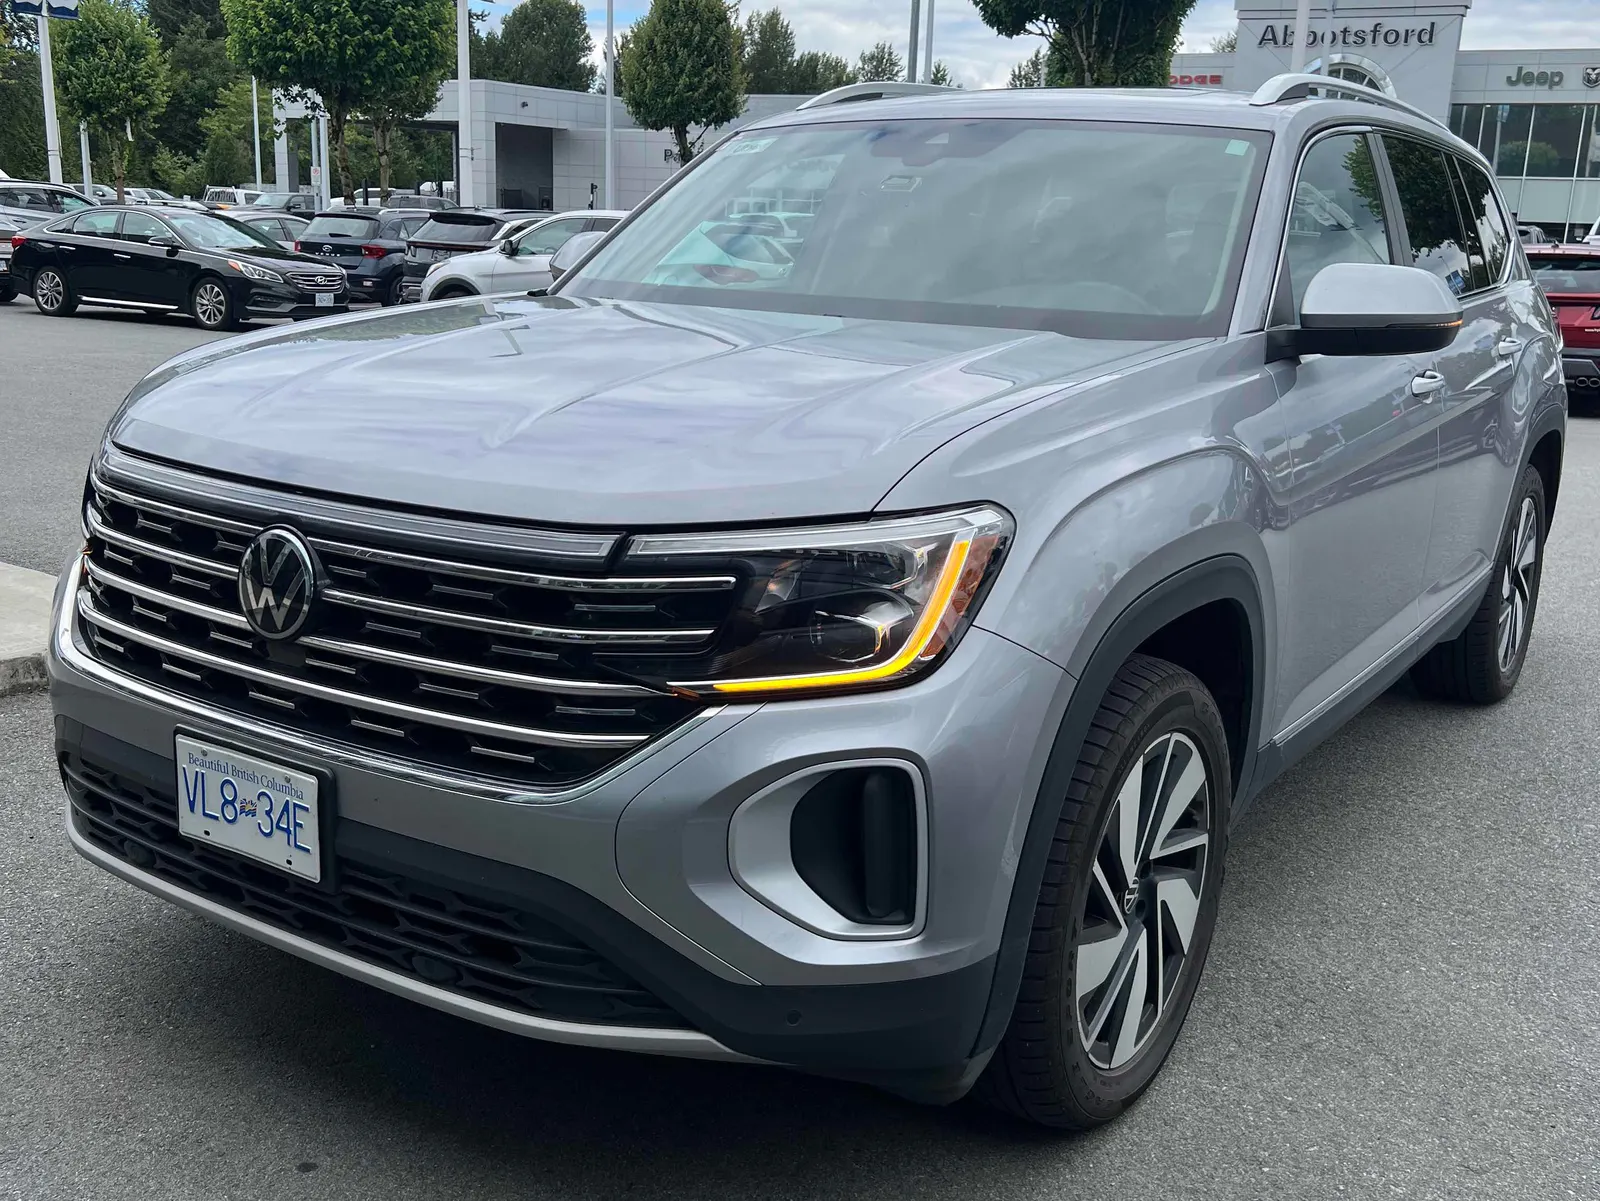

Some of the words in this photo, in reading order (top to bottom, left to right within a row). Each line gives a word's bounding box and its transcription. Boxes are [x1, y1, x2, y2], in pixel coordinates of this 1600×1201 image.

[1167, 74, 1222, 85] ODGE
[1506, 66, 1564, 90] Jeep
[188, 752, 230, 775] Beautiful
[231, 765, 259, 784] British
[260, 775, 304, 800] Columbia
